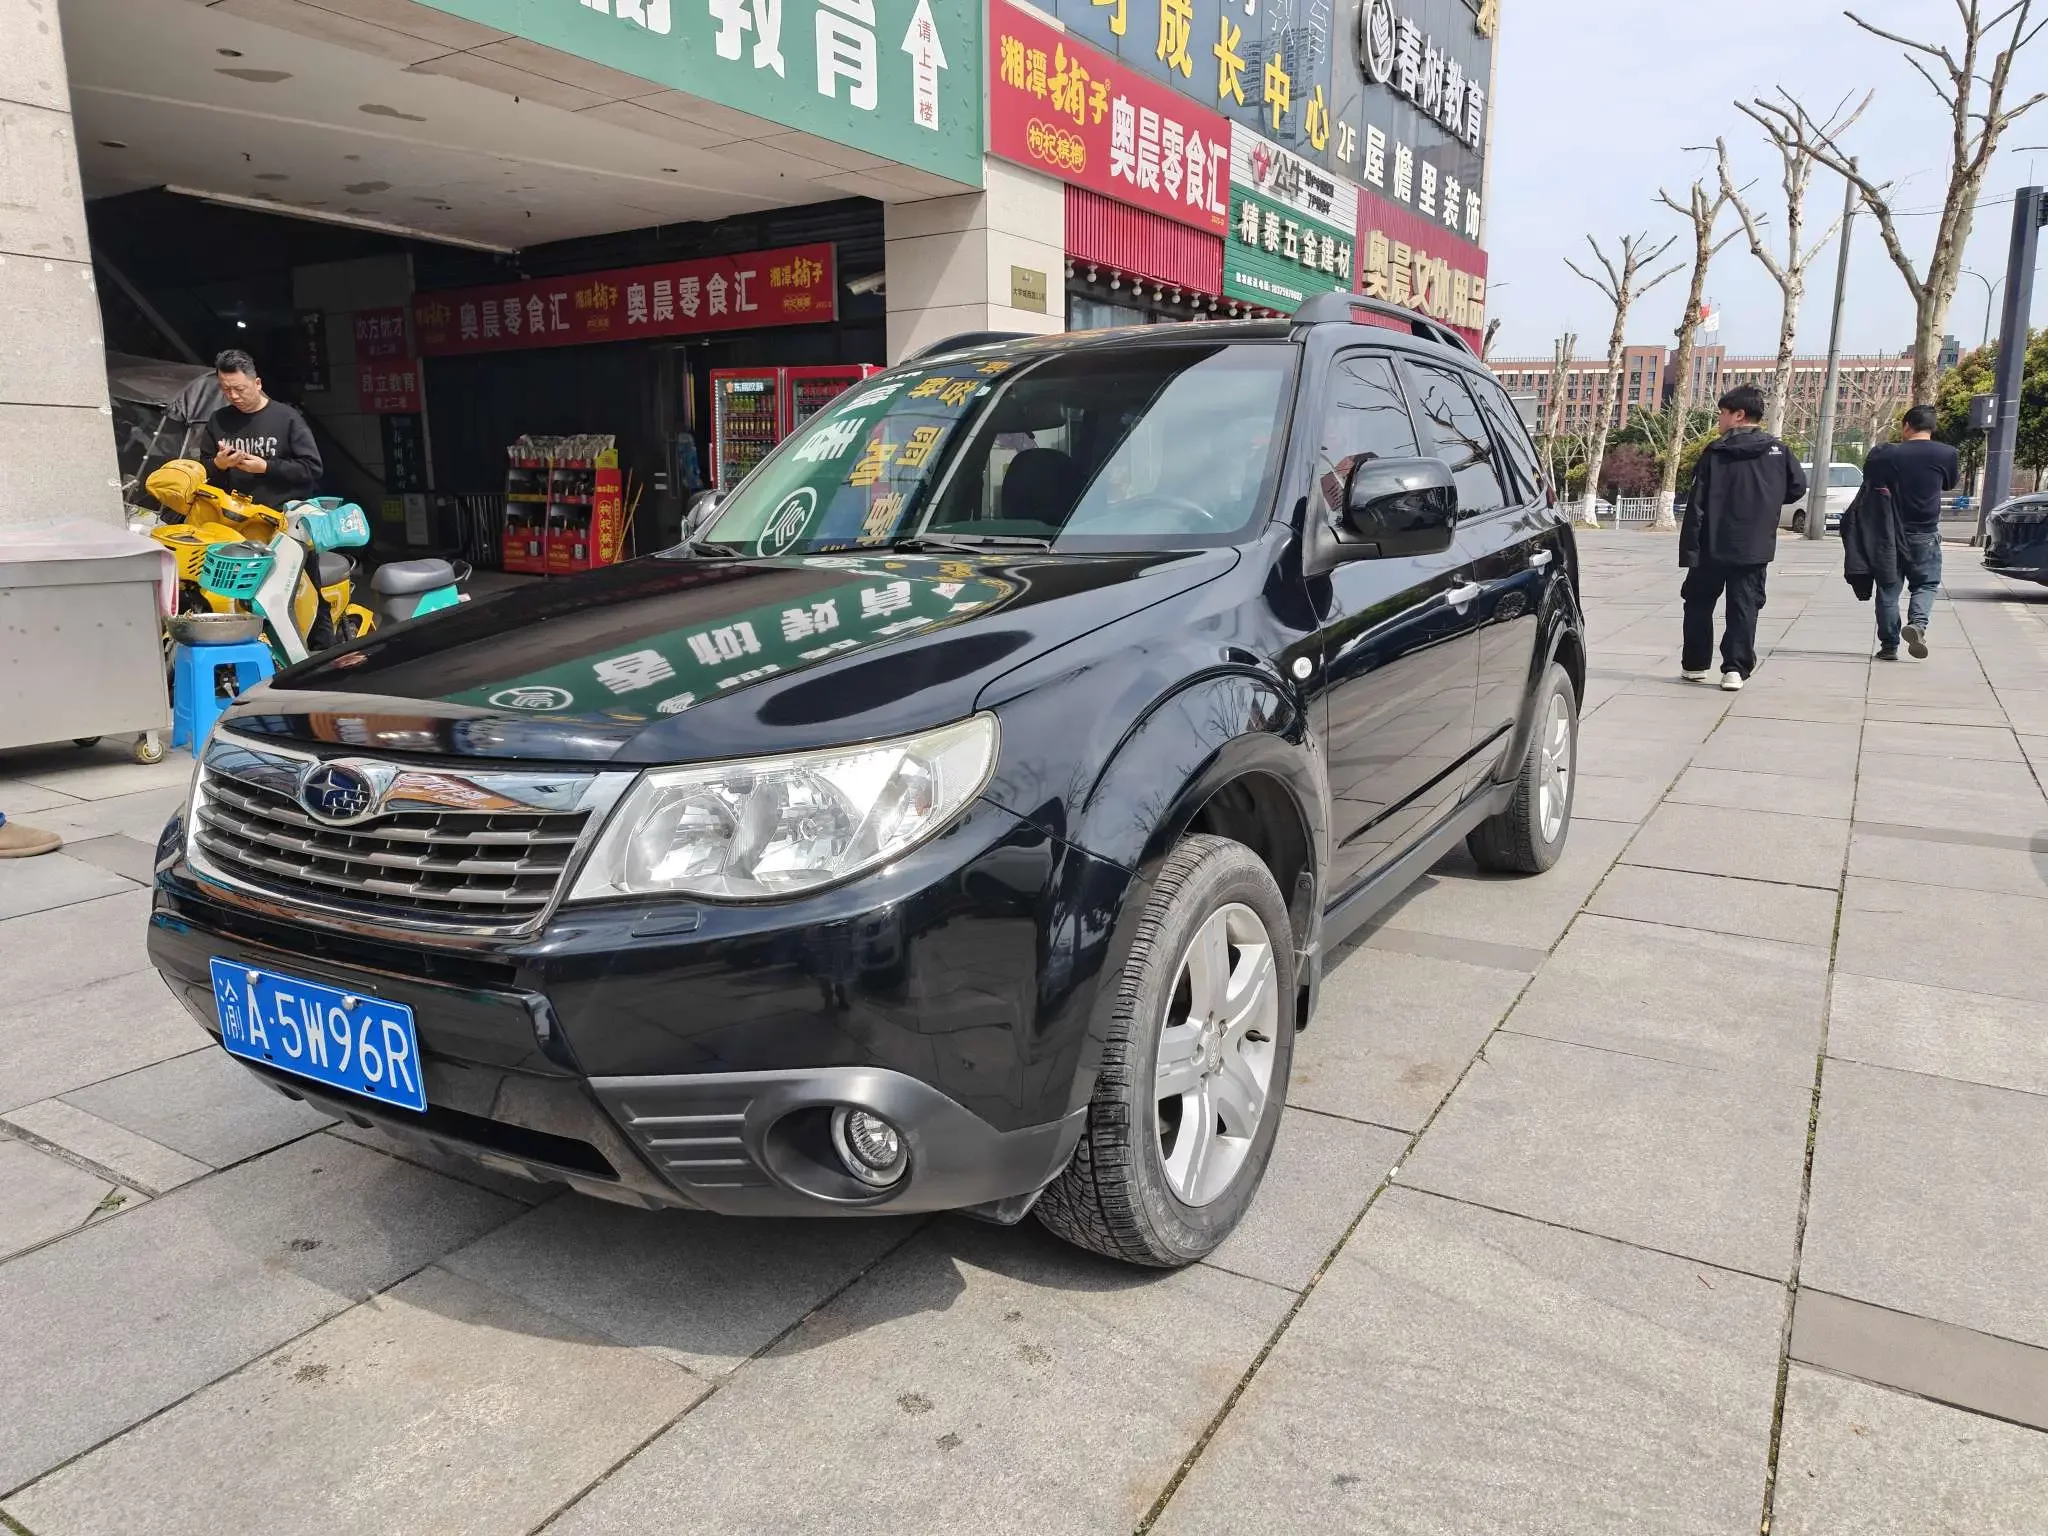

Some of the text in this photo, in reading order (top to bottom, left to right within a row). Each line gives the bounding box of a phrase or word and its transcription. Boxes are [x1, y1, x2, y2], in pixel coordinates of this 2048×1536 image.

[915, 17, 935, 124] 请上二楼
[1398, 16, 1484, 148] 春树教育
[1110, 95, 1227, 216] 奥晨零食汇
[1337, 121, 1481, 240] 2F 屋檐里装饰
[1237, 200, 1351, 279] 精泰五金建材
[459, 293, 570, 341] 奥晨零食汇
[627, 271, 758, 325] 奥晨零食汇
